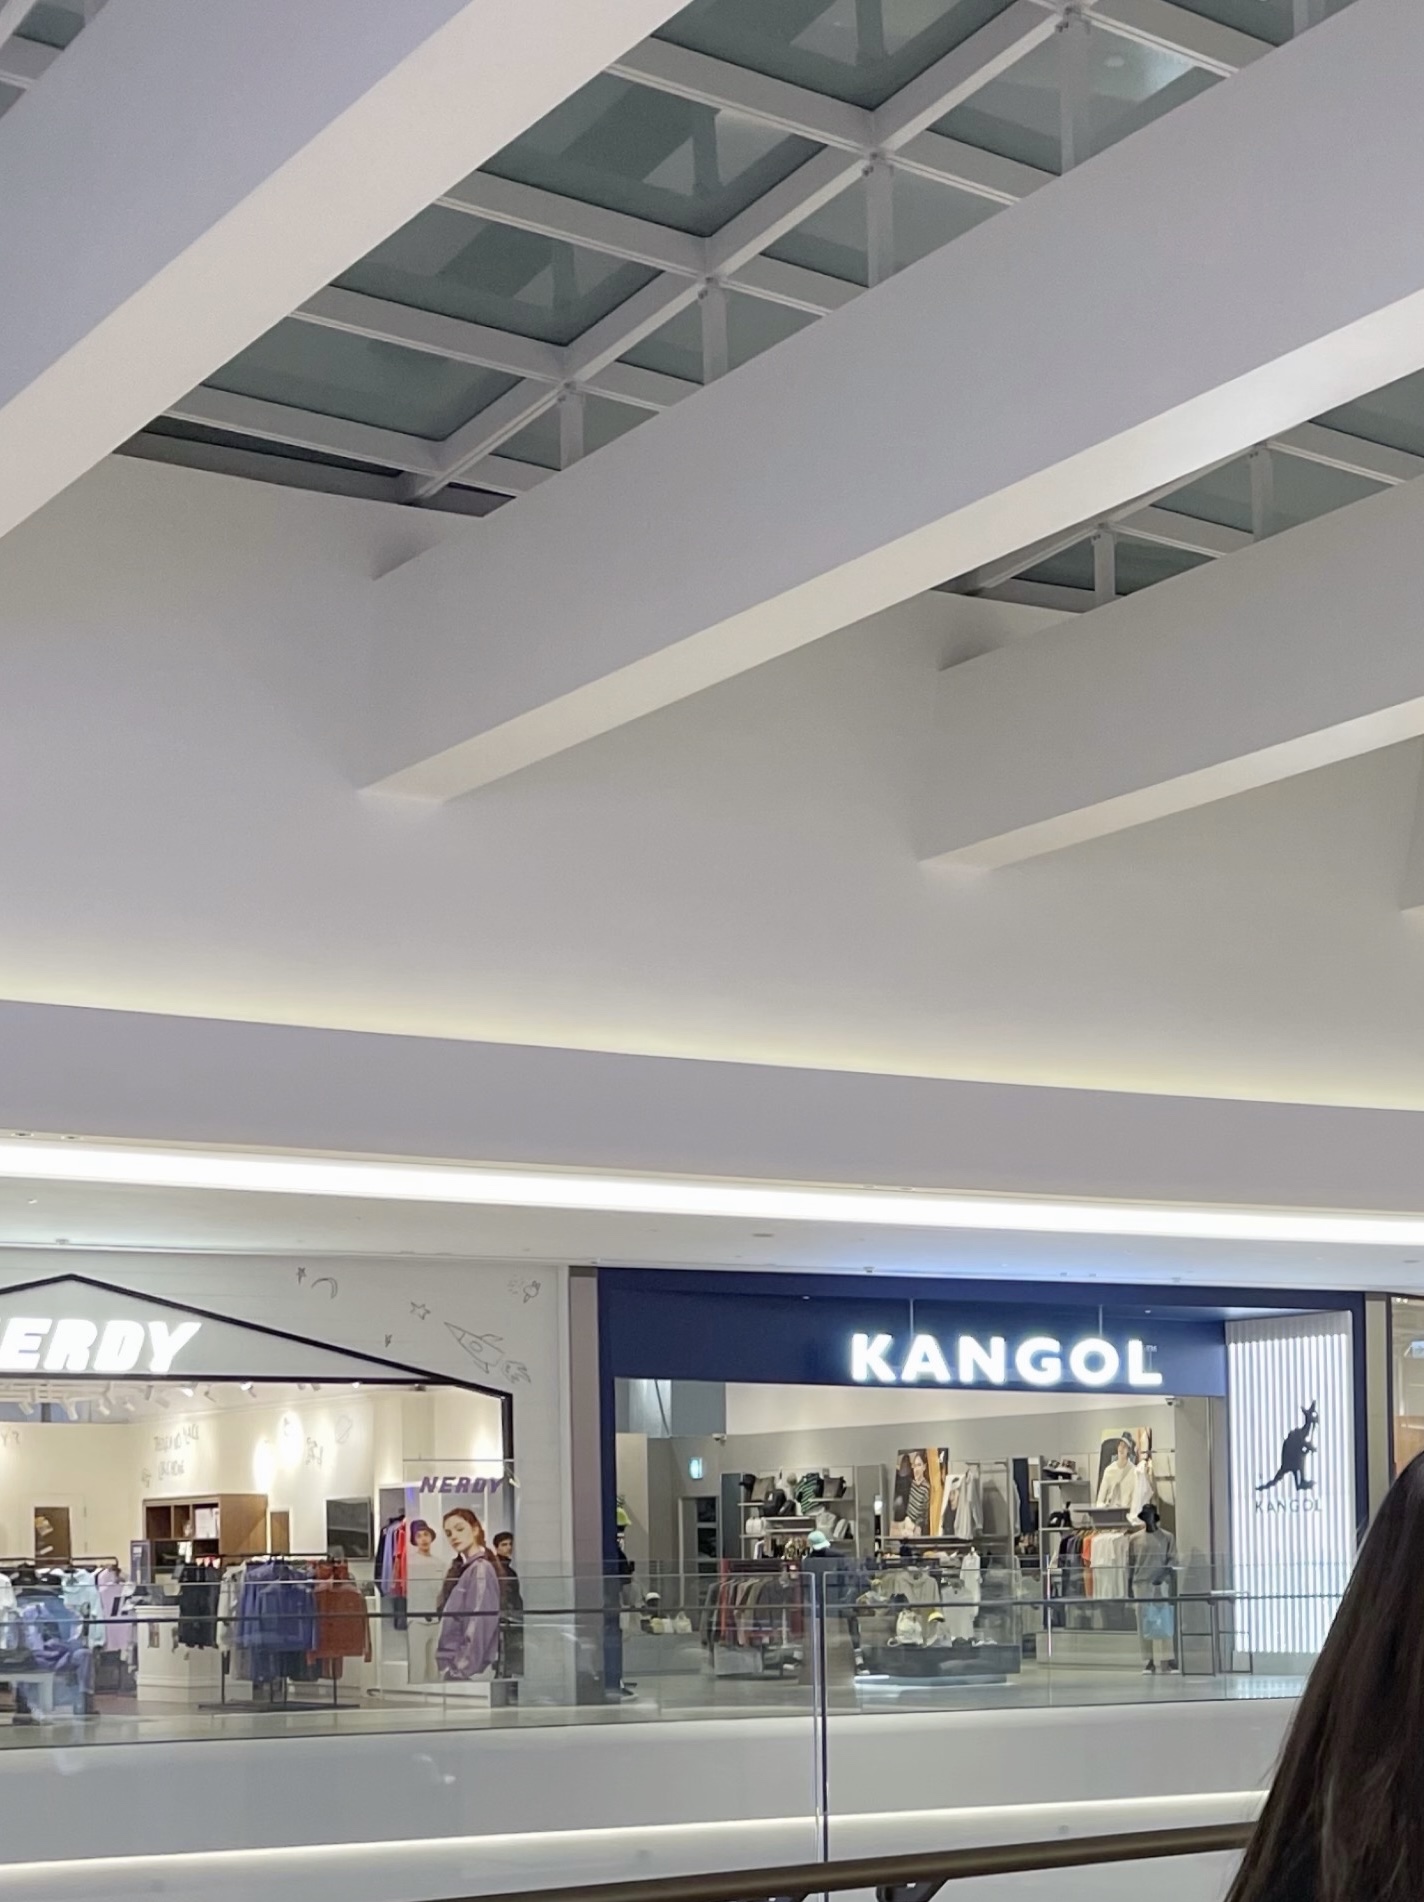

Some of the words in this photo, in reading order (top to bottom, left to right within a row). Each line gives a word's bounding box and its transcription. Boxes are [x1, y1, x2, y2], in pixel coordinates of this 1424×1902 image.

[0, 1317, 202, 1373] ERDY
[851, 1332, 1163, 1387] KANGOL
[419, 1476, 505, 1494] NERDY
[1255, 1499, 1322, 1514] KANGOL
